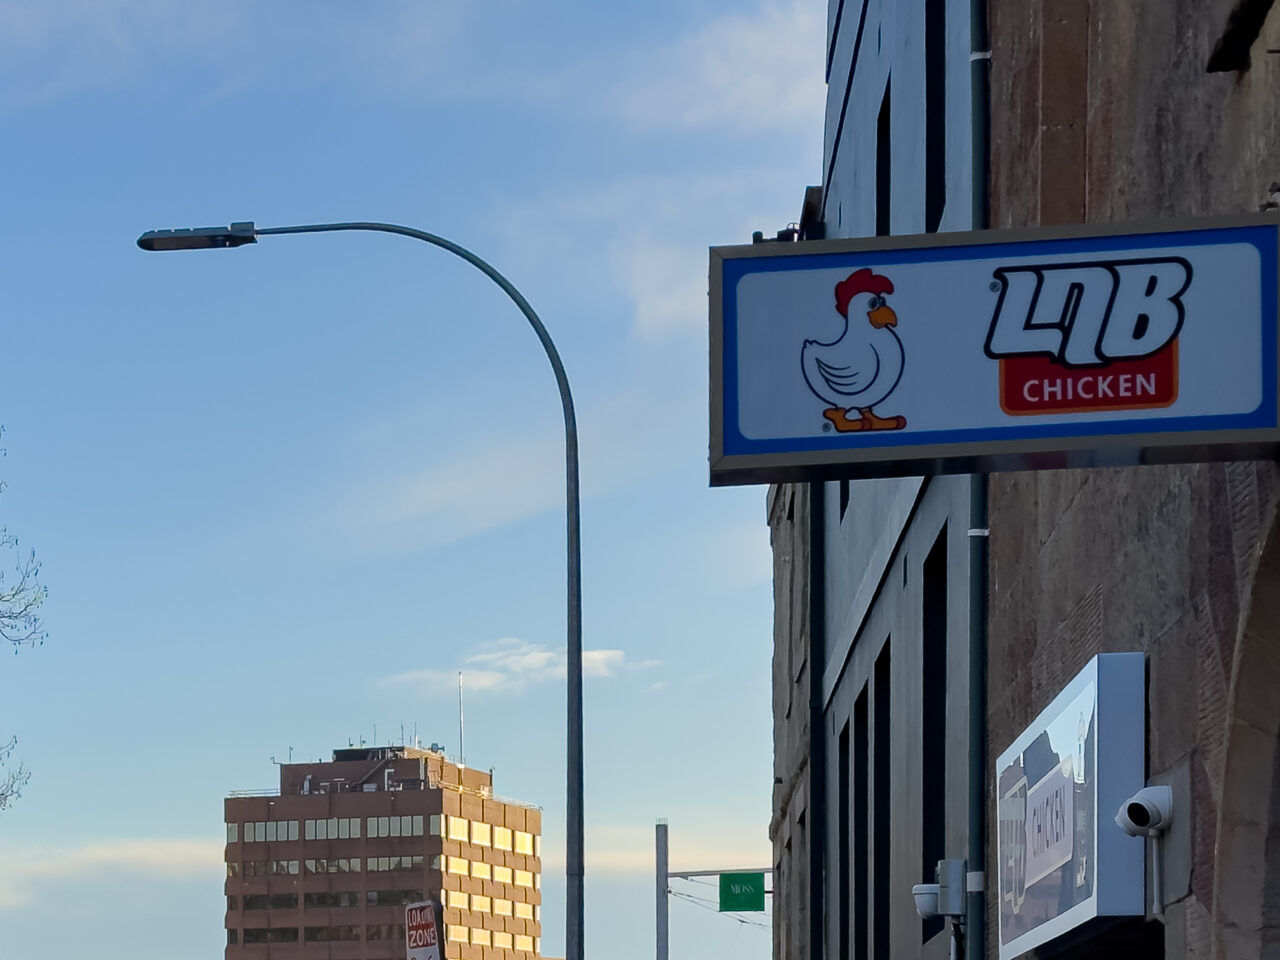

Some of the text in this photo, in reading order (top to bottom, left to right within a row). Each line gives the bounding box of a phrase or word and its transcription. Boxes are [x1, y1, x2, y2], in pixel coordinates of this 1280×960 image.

[1022, 372, 1157, 402] CHICKEN
[1031, 784, 1067, 858] CHICKEN
[408, 928, 437, 948] ZONE
